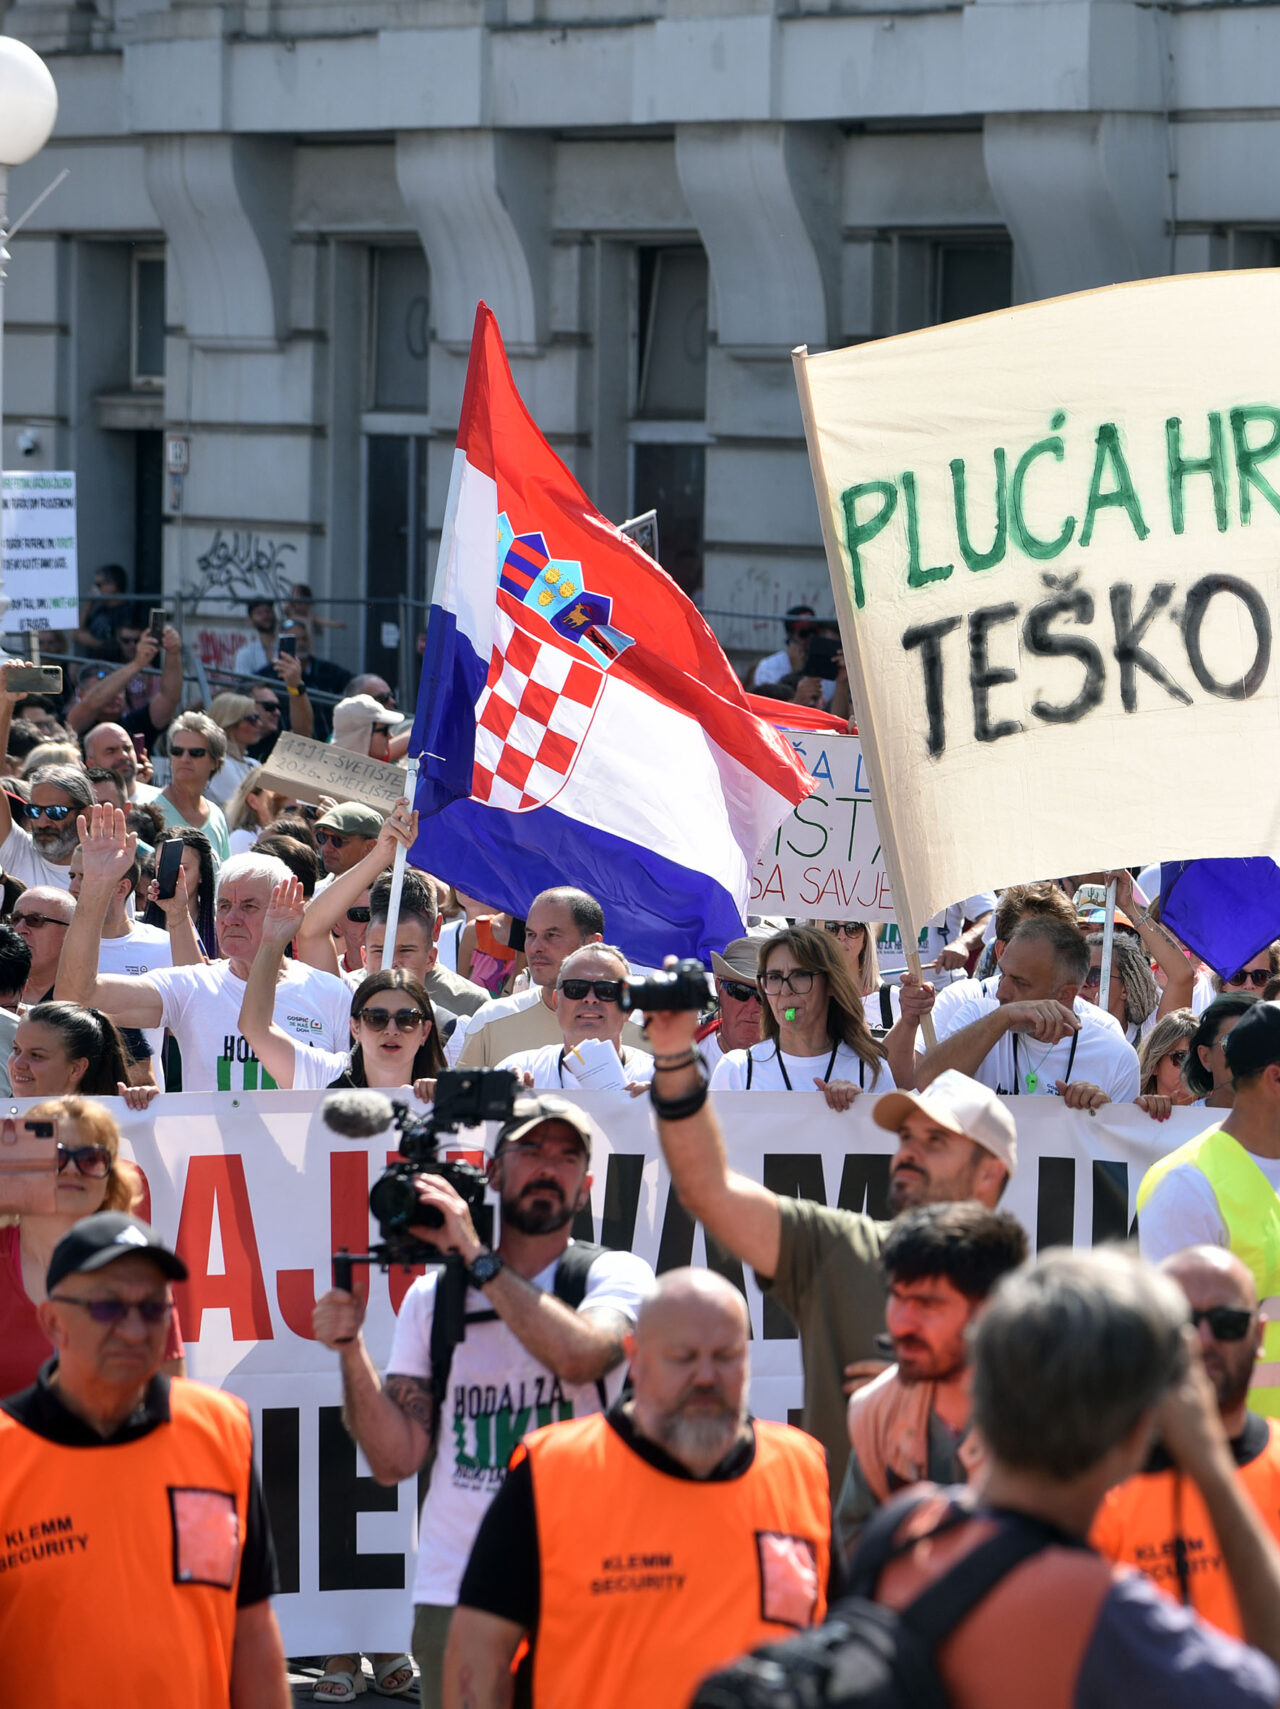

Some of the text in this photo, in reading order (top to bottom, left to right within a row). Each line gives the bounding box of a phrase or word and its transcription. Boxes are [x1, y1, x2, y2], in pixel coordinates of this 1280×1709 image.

[840, 411, 1152, 609] PLUĆA
[901, 569, 1274, 759] TEŠKO
[276, 756, 399, 800] 2026. SMETLIŠTE
[282, 737, 404, 788] 1991. SVETIŠTE
[799, 866, 894, 910] SAVJE
[5, 1515, 73, 1548] KLEMM
[601, 1553, 673, 1572] KLEMM
[590, 1573, 688, 1597] SECURITY
